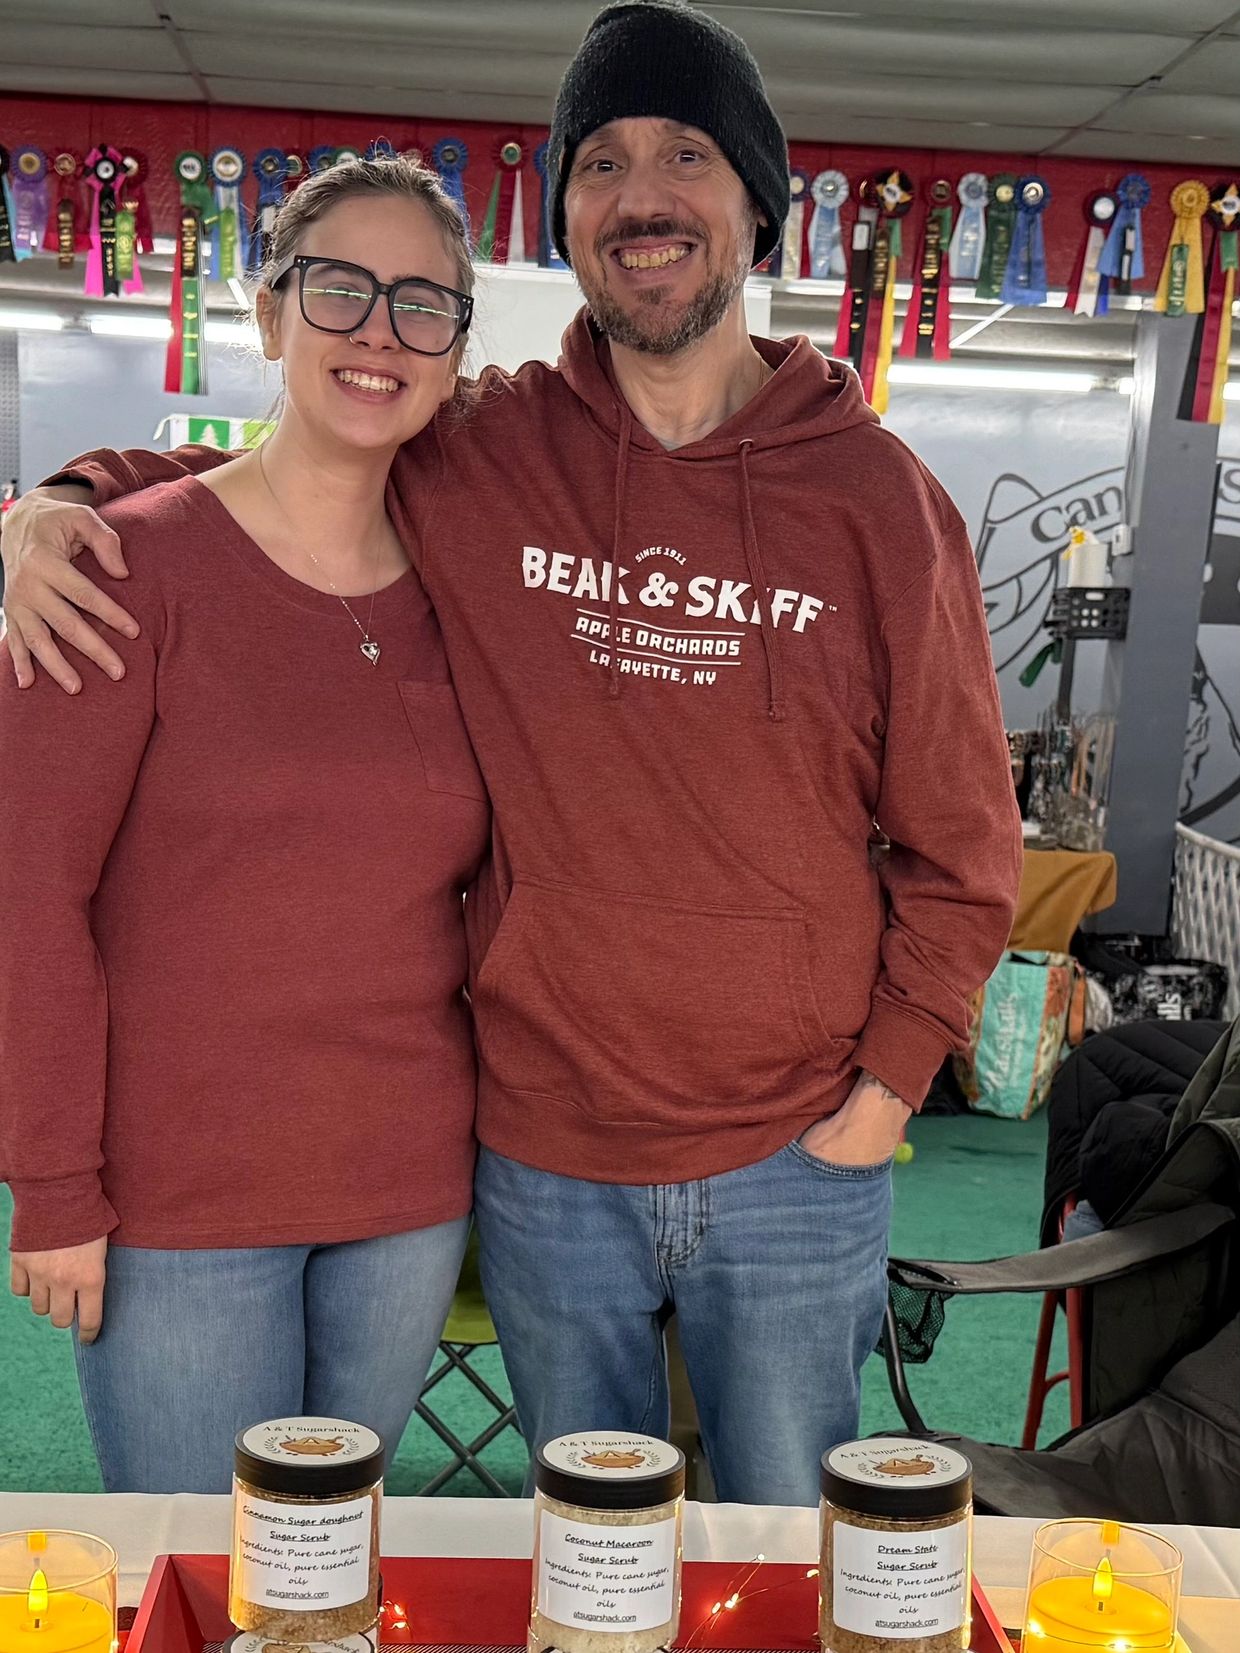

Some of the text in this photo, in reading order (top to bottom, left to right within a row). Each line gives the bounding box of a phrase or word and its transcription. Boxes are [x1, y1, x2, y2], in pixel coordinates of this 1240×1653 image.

[635, 546, 687, 566] SINCE 1911
[639, 572, 679, 607] &
[635, 630, 741, 656] ORCHARDS
[589, 650, 717, 685] LAAYETTE, NY
[288, 1516, 317, 1527] Sugar
[270, 1530, 331, 1543] Sugar Scrub
[564, 1533, 653, 1550] Coconut Macaroon
[288, 1549, 312, 1558] Pure
[314, 1549, 338, 1558] cane
[877, 1545, 913, 1555] Dream
[243, 1553, 360, 1573] coconut oil, pure essential
[577, 1552, 639, 1566] Sugar Scrub
[877, 1561, 938, 1572] Sugar Scrub
[288, 1578, 308, 1586] oils
[596, 1571, 620, 1580] Pure
[622, 1571, 646, 1581] cane
[840, 1568, 893, 1586] Ingredients:
[896, 1578, 922, 1587] Pure
[923, 1576, 946, 1585] cane
[548, 1575, 665, 1596] coconut oil, pure essential
[845, 1581, 962, 1602] coconut oil, pure essential
[596, 1600, 616, 1608] oils
[899, 1606, 919, 1614] oils
